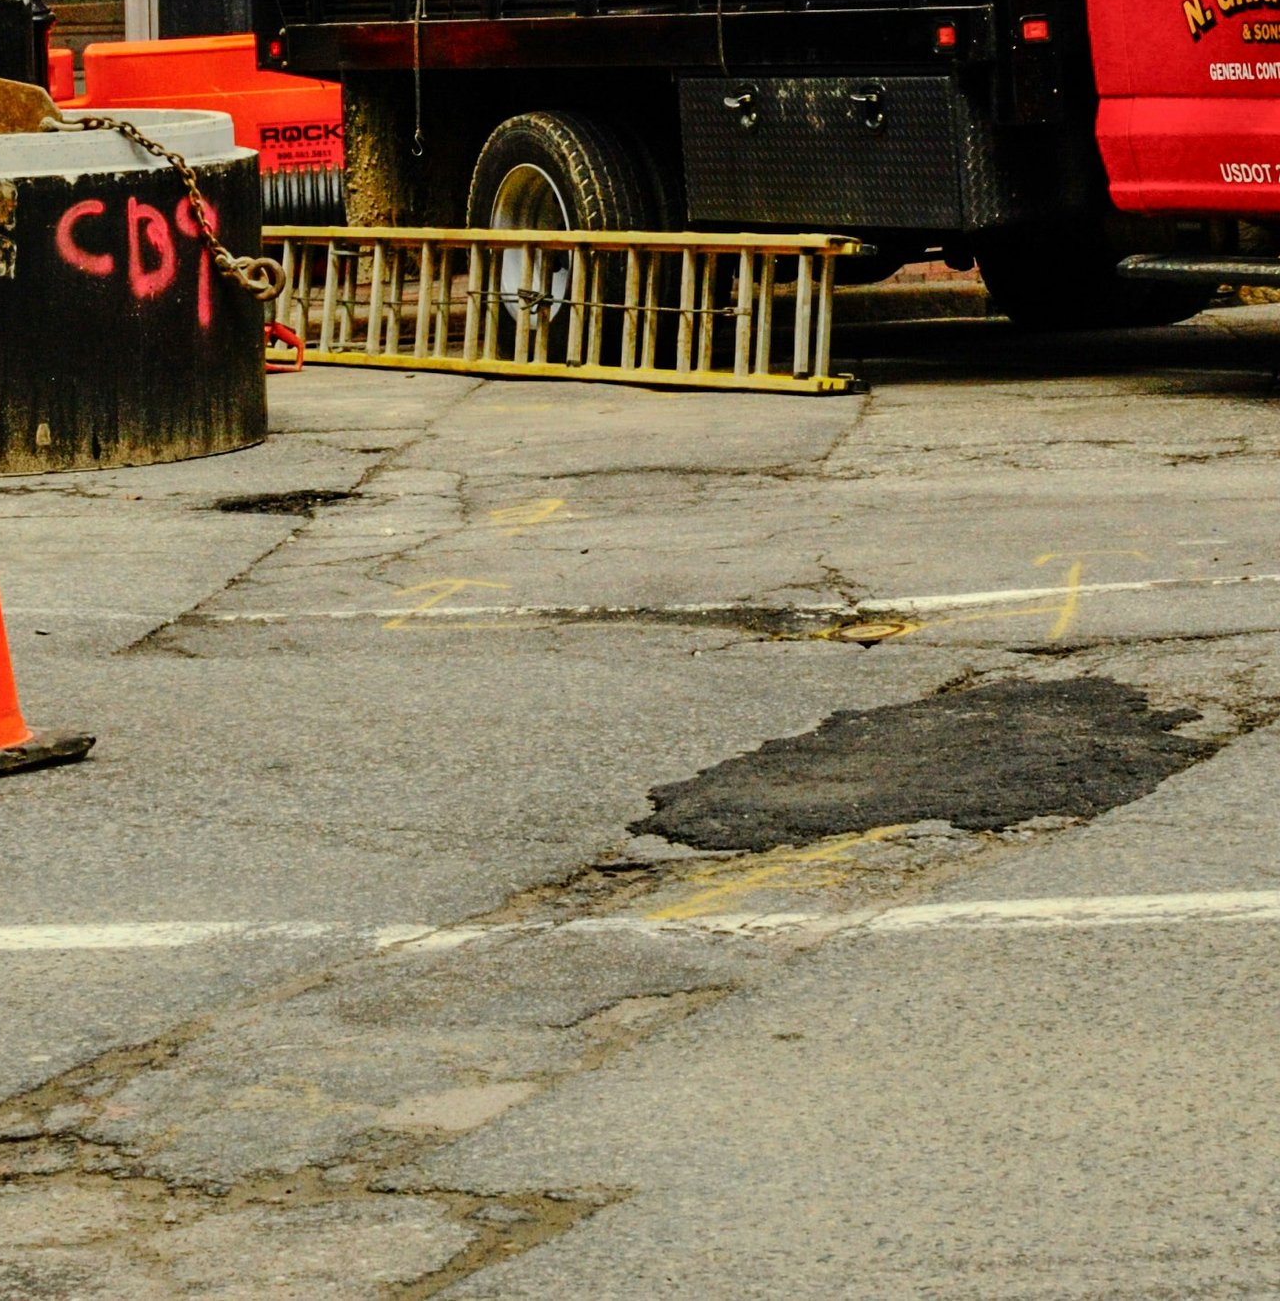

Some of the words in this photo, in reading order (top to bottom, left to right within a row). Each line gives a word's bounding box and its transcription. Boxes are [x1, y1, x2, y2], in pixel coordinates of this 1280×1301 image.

[1242, 23, 1252, 41] &
[1210, 62, 1255, 81] GENERAL
[261, 123, 343, 144] ROCK
[1220, 164, 1273, 184] USDOT
[56, 195, 218, 331] CD9
